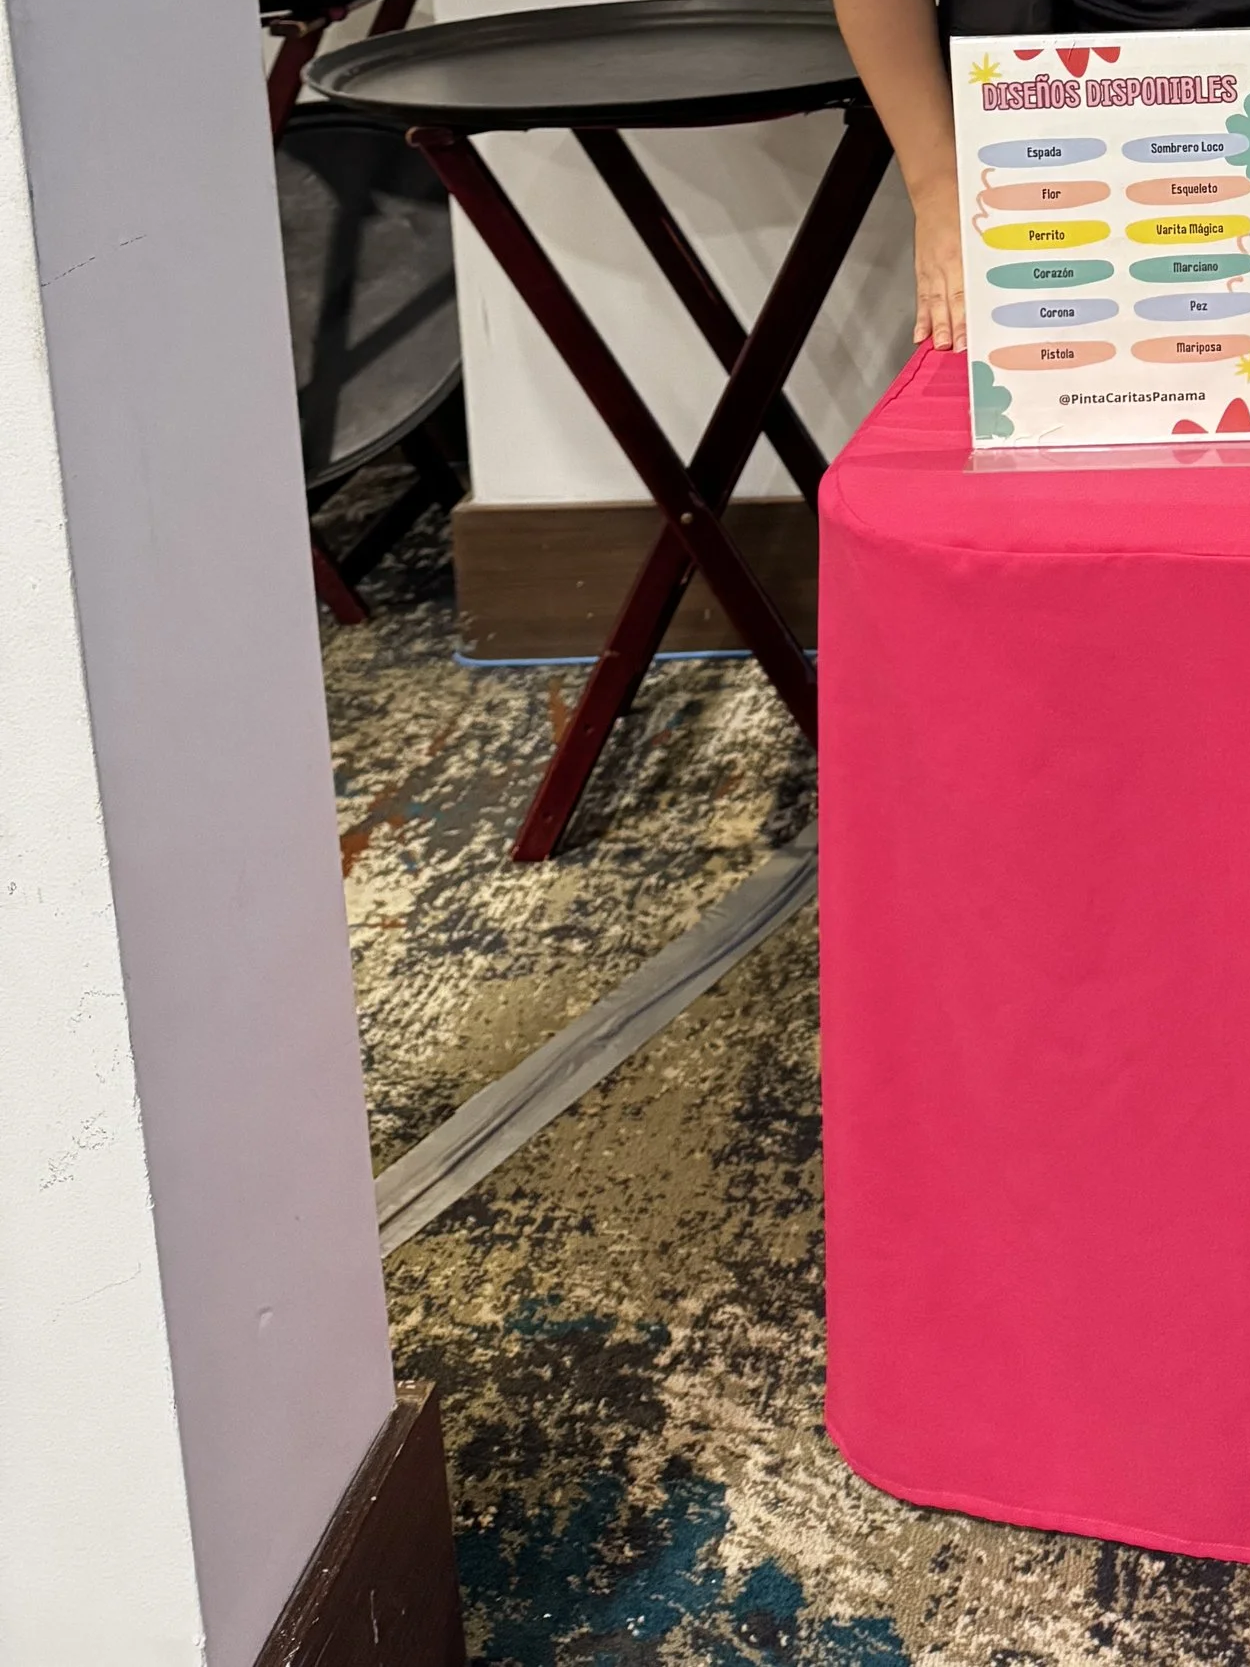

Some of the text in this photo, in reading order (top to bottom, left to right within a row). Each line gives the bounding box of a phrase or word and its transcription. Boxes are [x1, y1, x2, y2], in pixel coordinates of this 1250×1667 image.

[982, 74, 1238, 111] DISEÑOS DISPONIBLES
[1027, 147, 1061, 160] Espada
[1151, 141, 1224, 154] Sombrero Loco
[1042, 189, 1061, 200] Flor
[1171, 183, 1218, 197] Esqueleto
[1029, 230, 1065, 241] Perrito
[1156, 223, 1224, 236] Varita Mágica
[1033, 267, 1074, 279] Corazón
[1173, 262, 1219, 273] Marciano
[1190, 300, 1207, 311] Pez
[1039, 307, 1075, 318] Corona
[1041, 348, 1074, 360] Pistola
[1176, 342, 1222, 354] Mariposa
[1058, 392, 1206, 406] @PintaCaritasPanama
